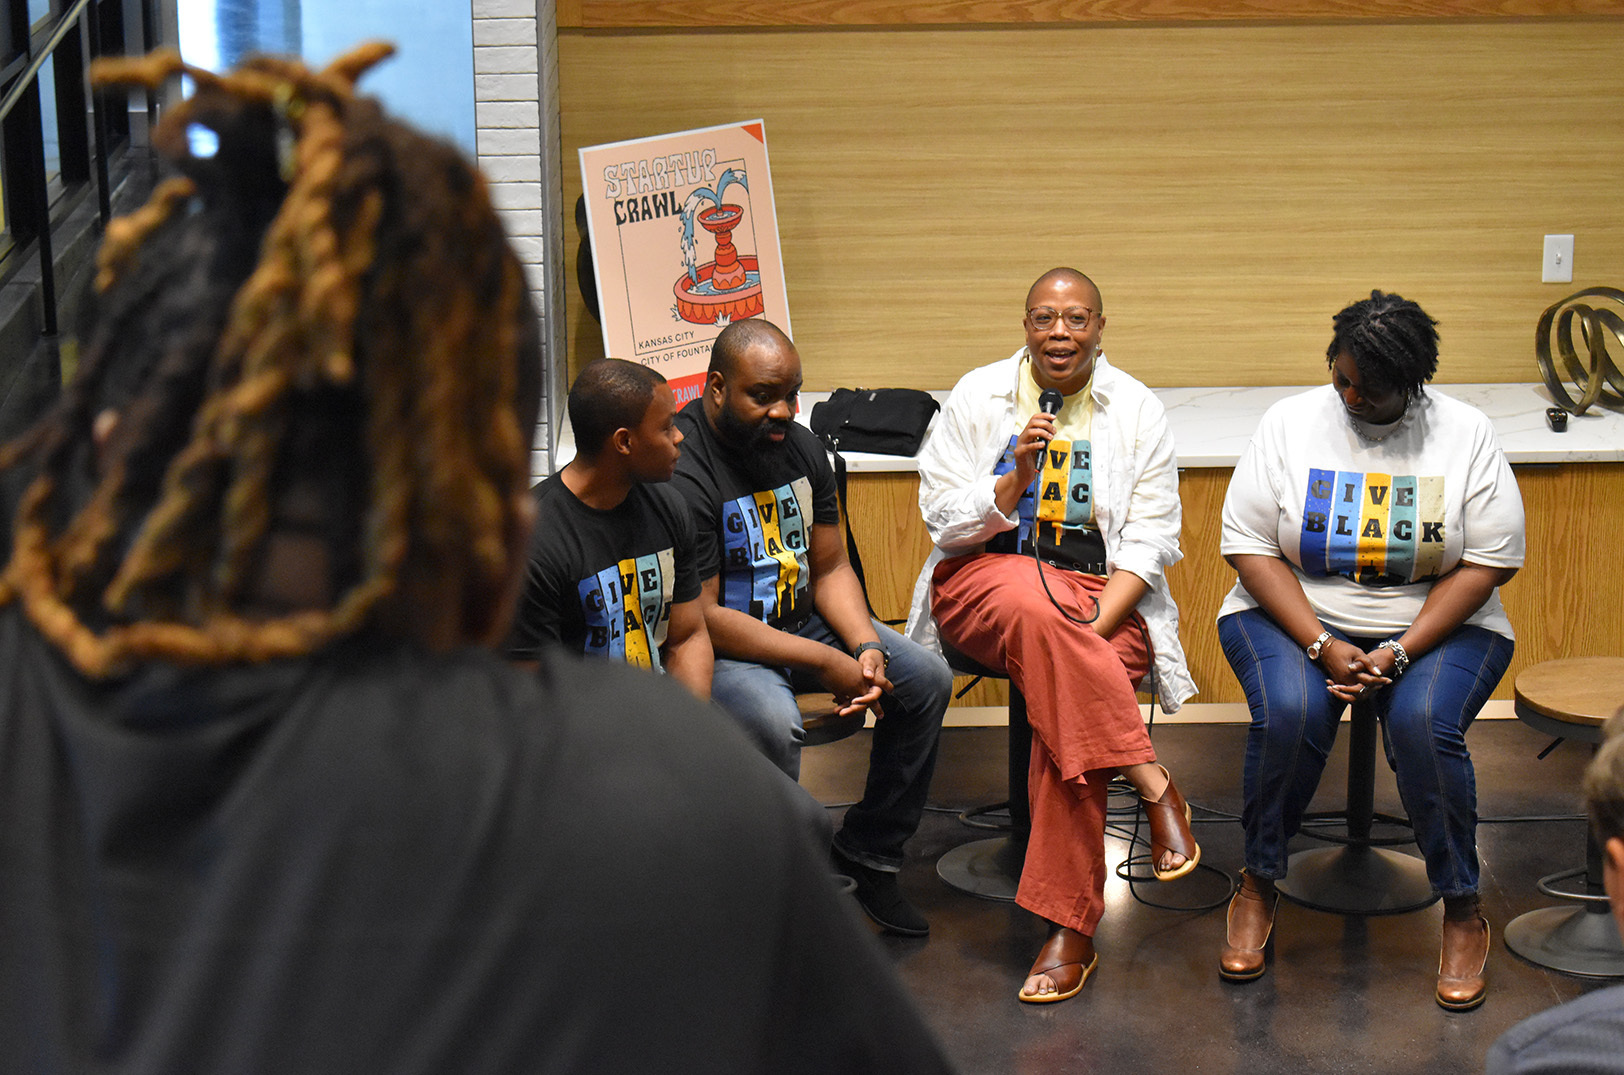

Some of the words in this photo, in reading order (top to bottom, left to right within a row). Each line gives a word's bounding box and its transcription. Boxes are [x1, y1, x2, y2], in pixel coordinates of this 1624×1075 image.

[604, 148, 716, 199] STARTUP
[614, 191, 683, 226] CRAWL
[638, 335, 674, 350] KANSAS
[675, 331, 695, 342] CITY
[640, 355, 661, 366] CITY
[663, 351, 675, 362] OF
[1311, 480, 1414, 507] GIVE
[727, 497, 797, 533] GIVE
[1305, 511, 1444, 543] BLACK
[729, 527, 812, 566] BLAC
[585, 568, 658, 612] GIVE
